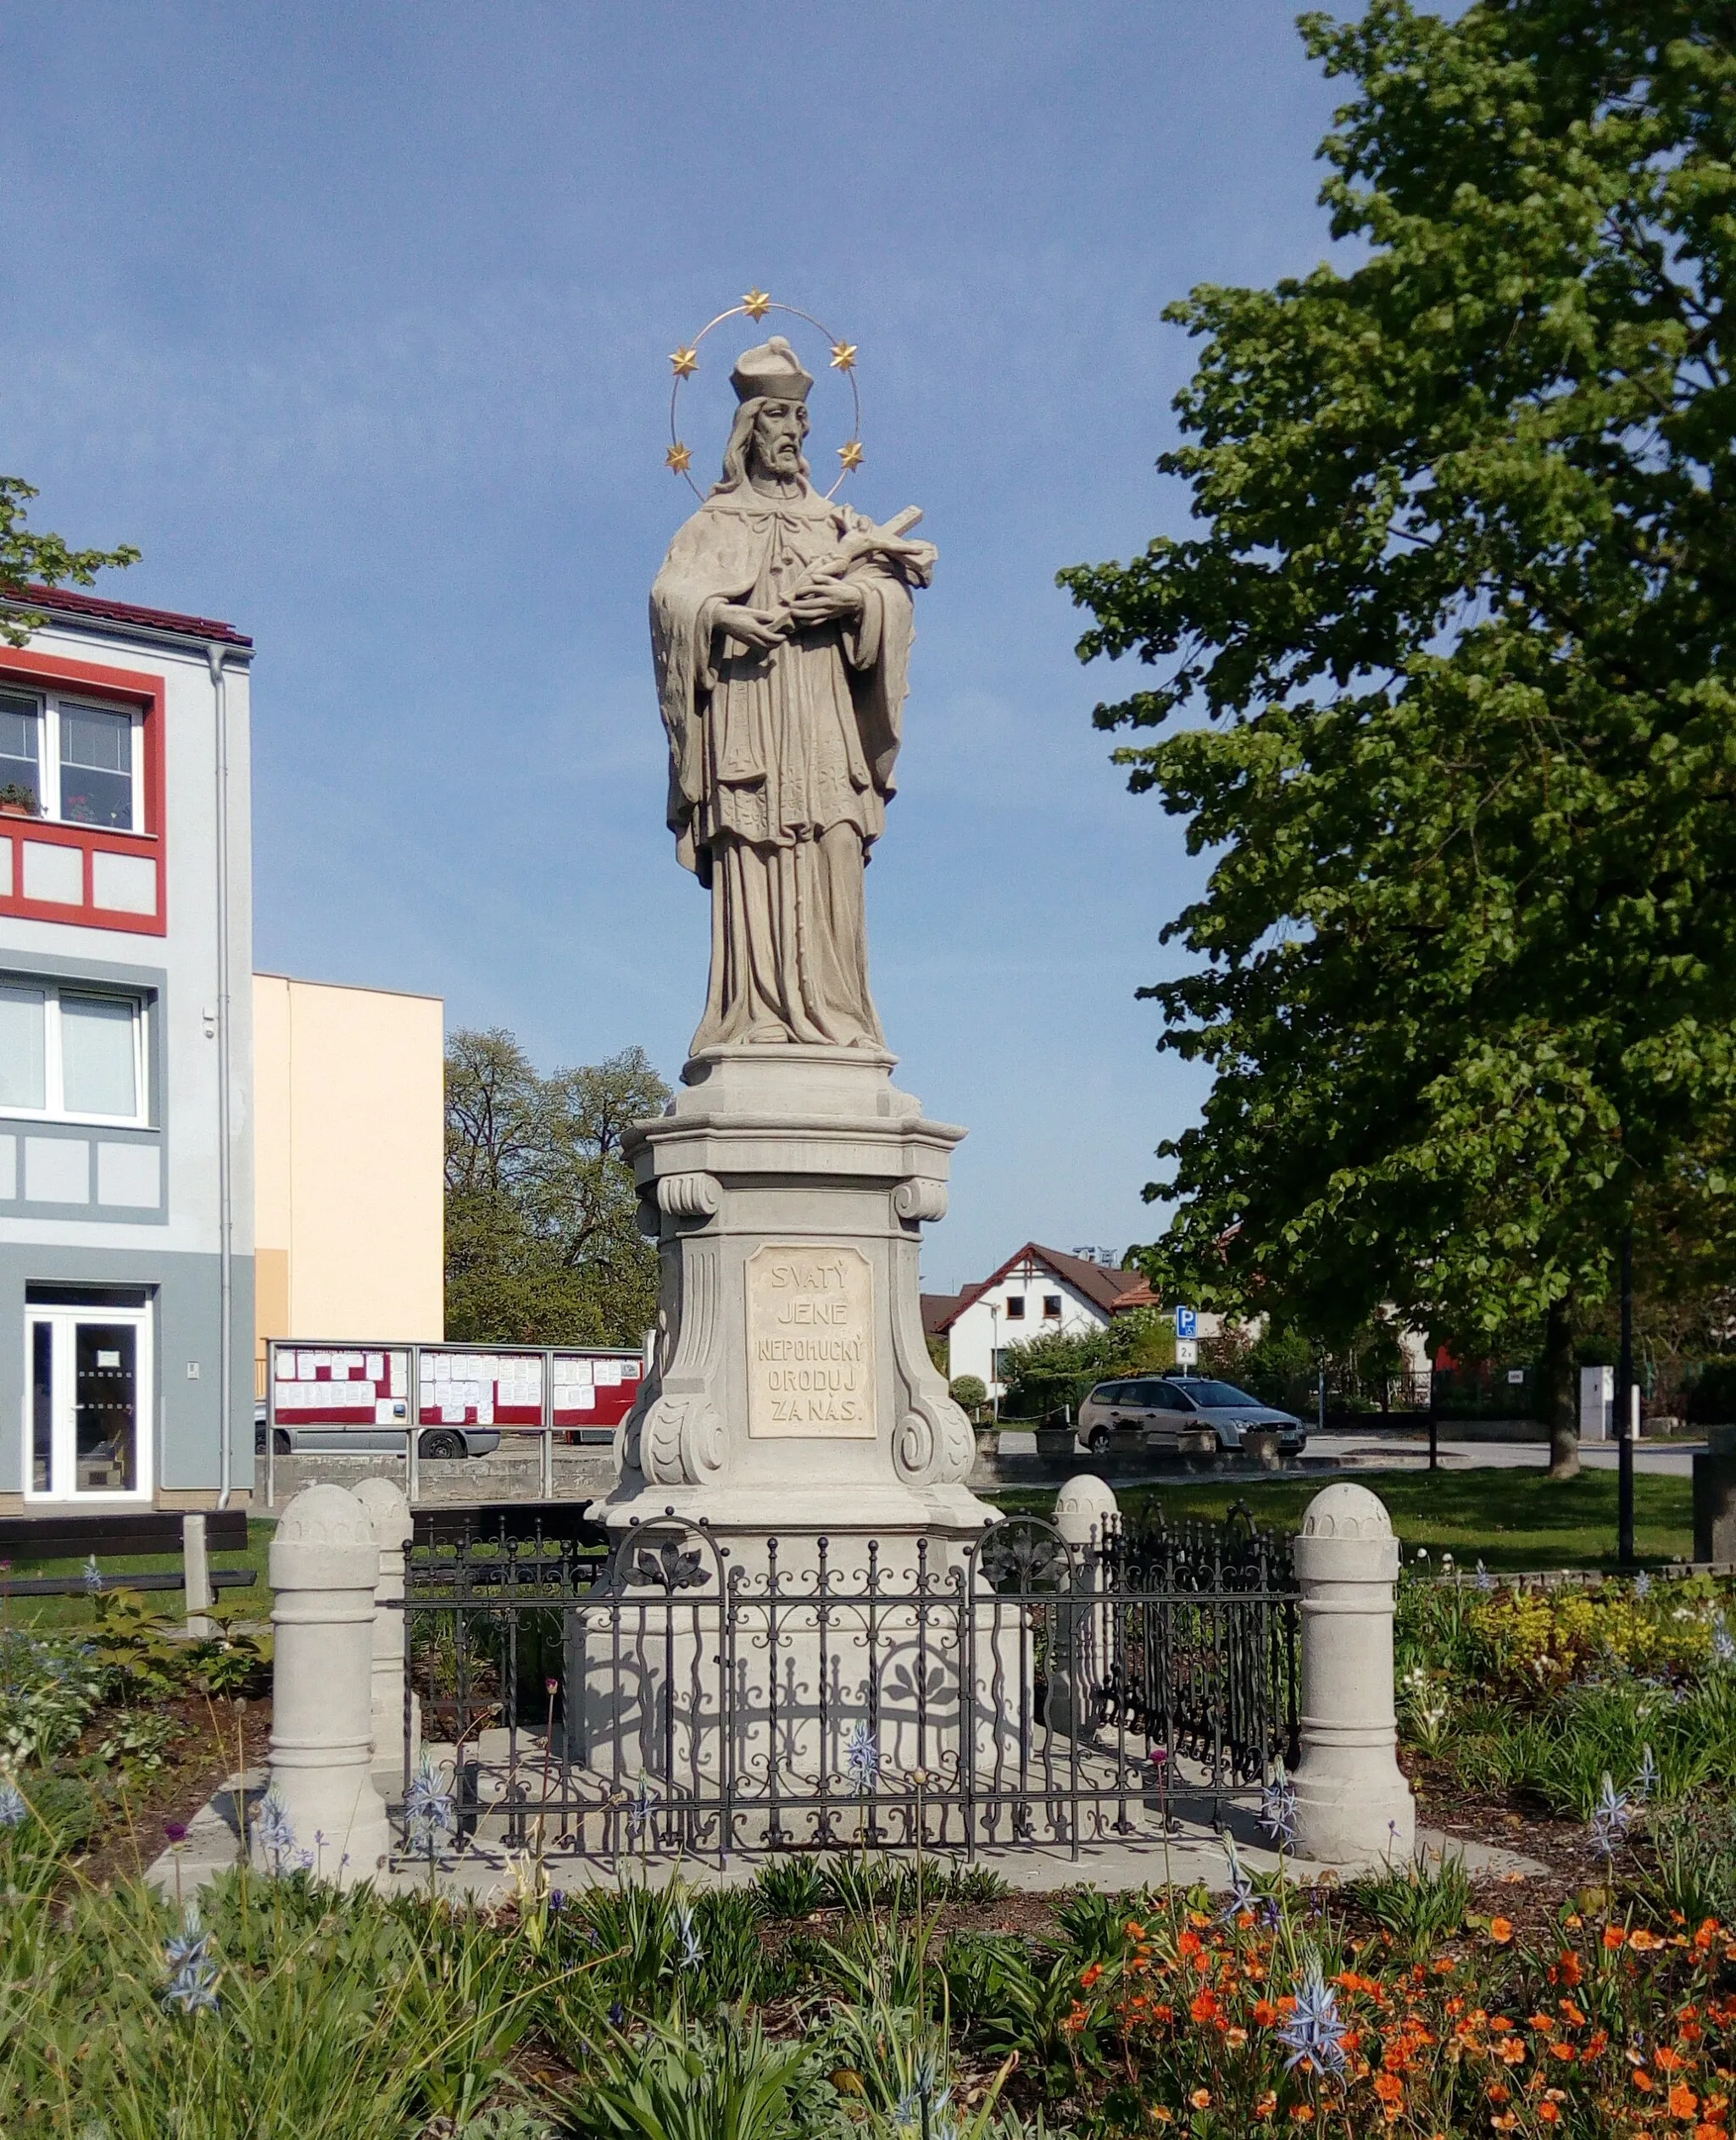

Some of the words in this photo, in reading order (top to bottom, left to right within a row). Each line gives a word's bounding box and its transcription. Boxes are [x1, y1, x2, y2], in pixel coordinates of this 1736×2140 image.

[771, 1259, 848, 1289] SVATÝ
[777, 1303, 848, 1325] JENE
[1181, 1309, 1194, 1328] P
[757, 1334, 863, 1362] NEPOMUCKÝ
[768, 1369, 857, 1392] ORODUJ
[771, 1398, 803, 1421] ZA
